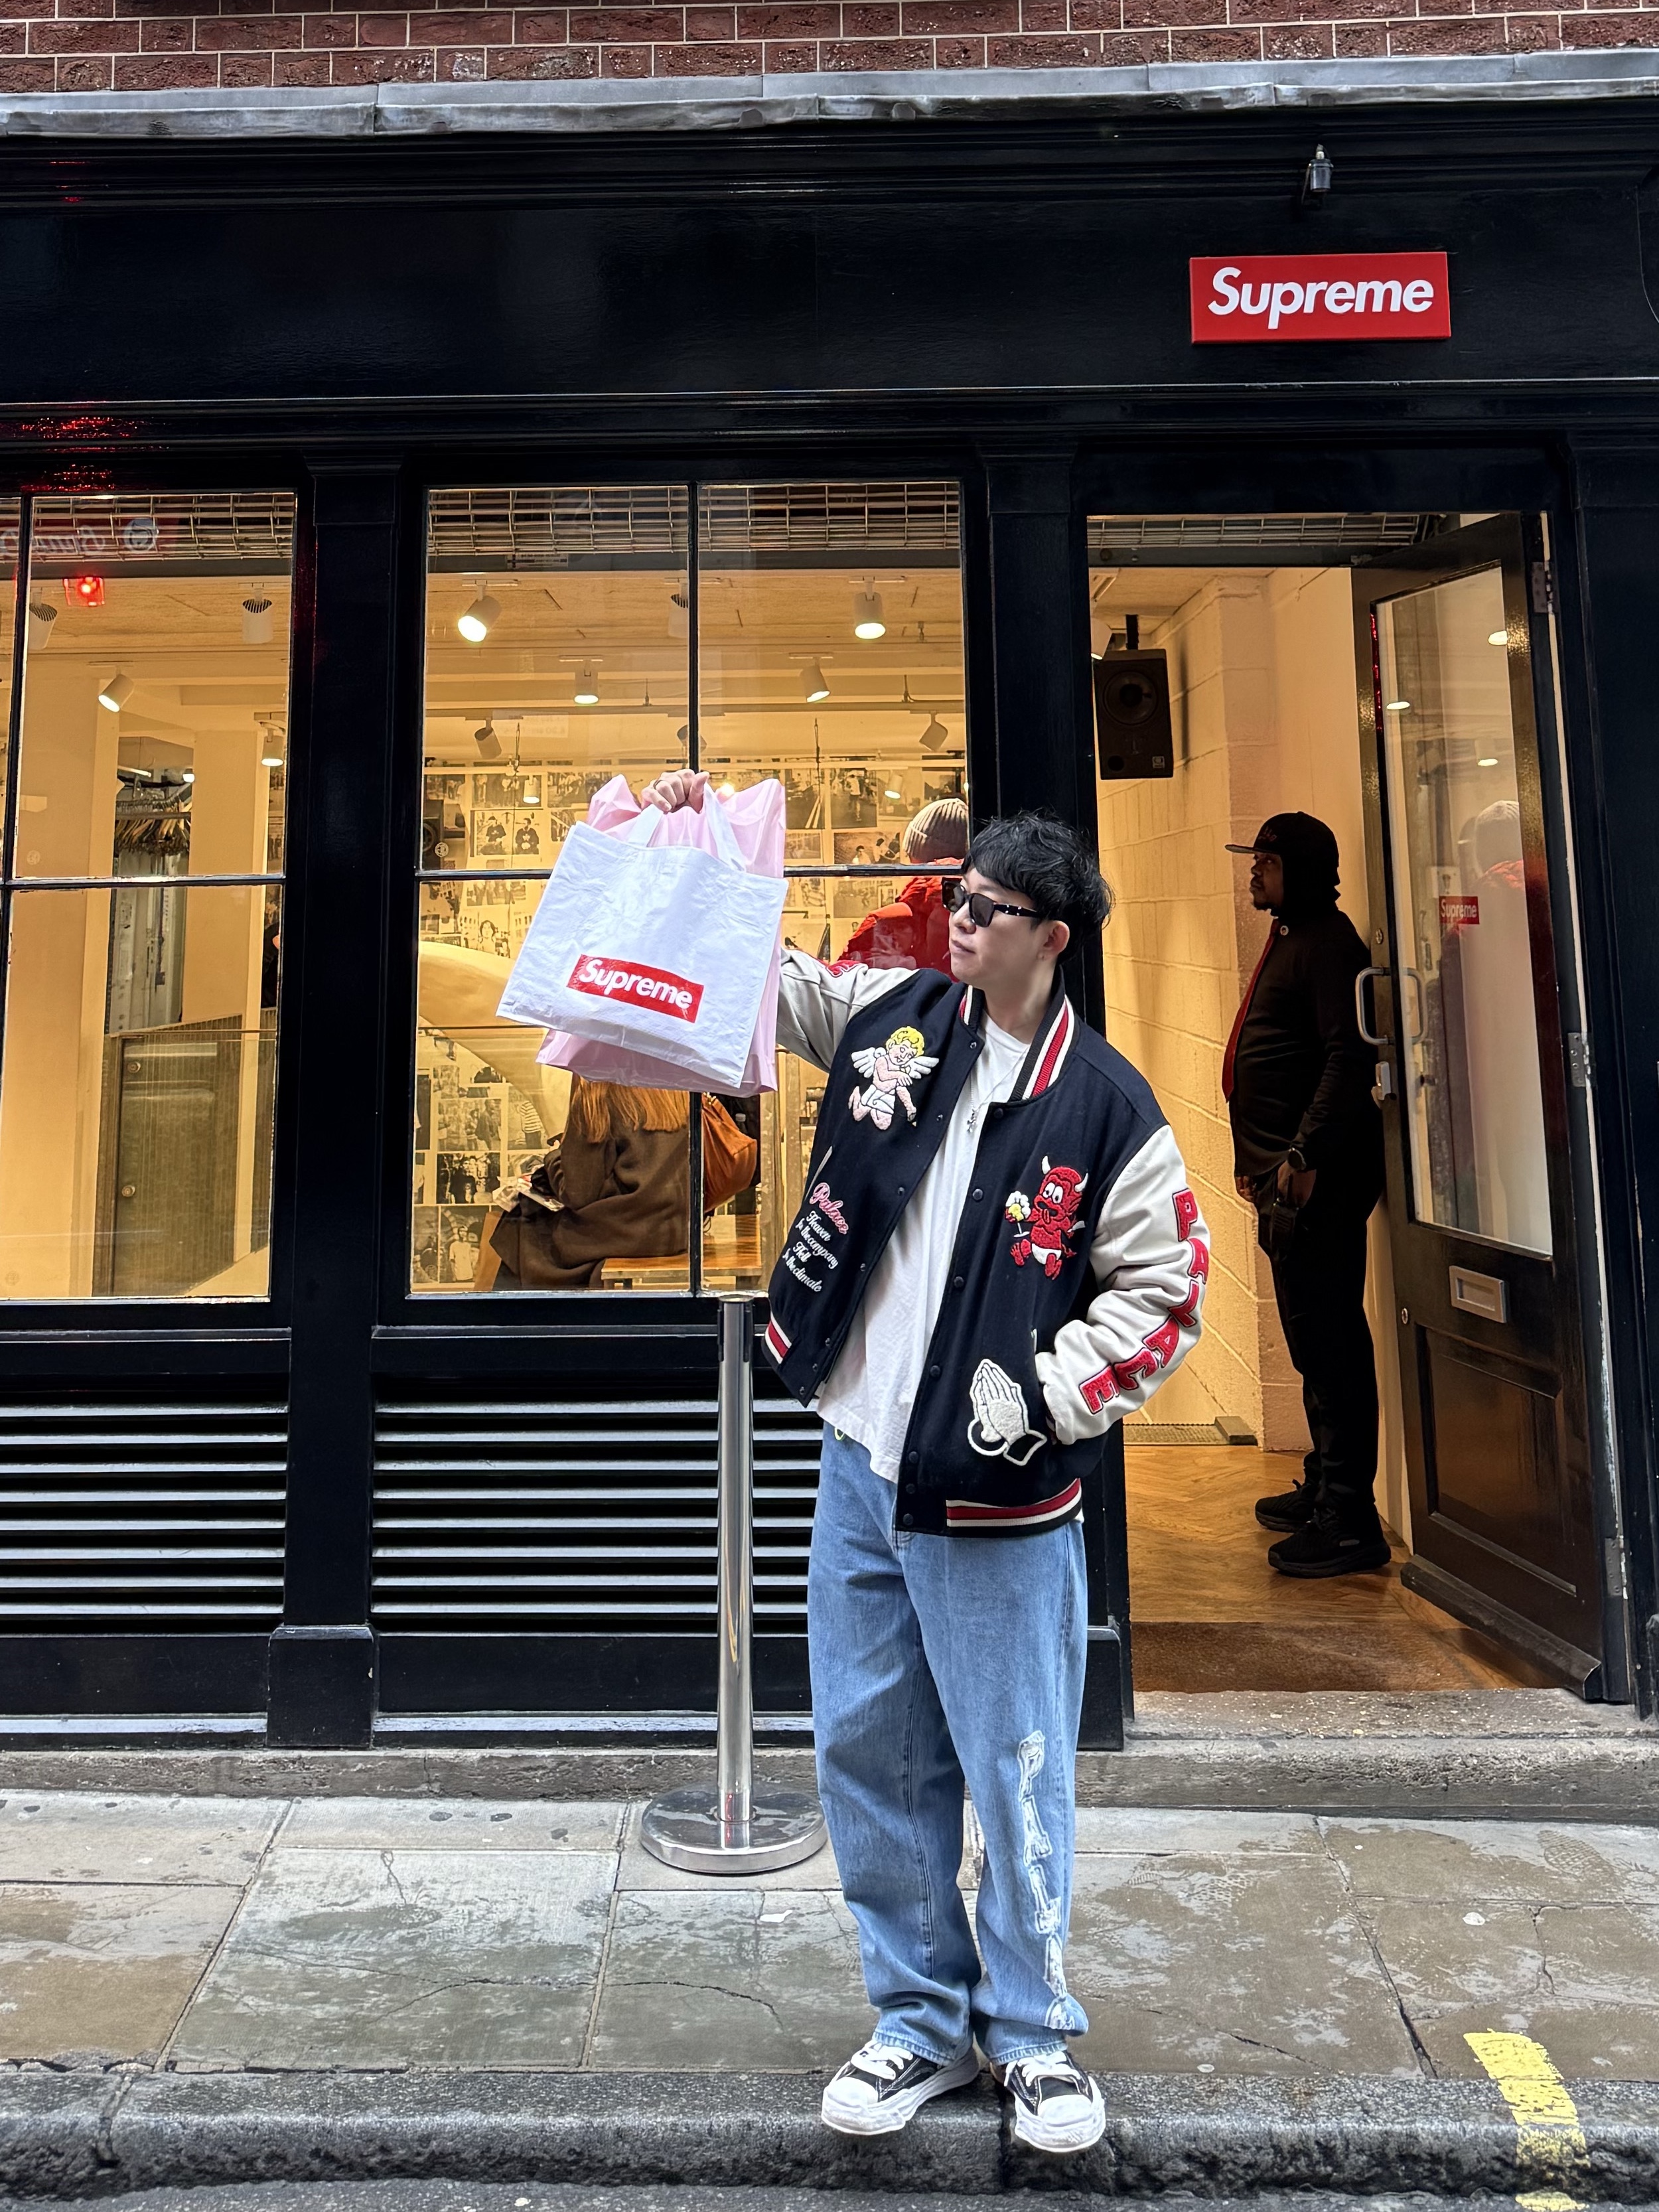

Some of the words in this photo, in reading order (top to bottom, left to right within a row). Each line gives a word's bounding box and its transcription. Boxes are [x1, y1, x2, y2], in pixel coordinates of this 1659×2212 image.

[1208, 267, 1434, 329] Supreme
[1441, 899, 1477, 924] Supreme
[578, 959, 693, 1009] Supreme
[810, 1182, 849, 1234] Palace
[806, 1211, 831, 1242] Heaven
[793, 1241, 812, 1263] Hell
[807, 1237, 839, 1270] company
[792, 1267, 823, 1292] climate
